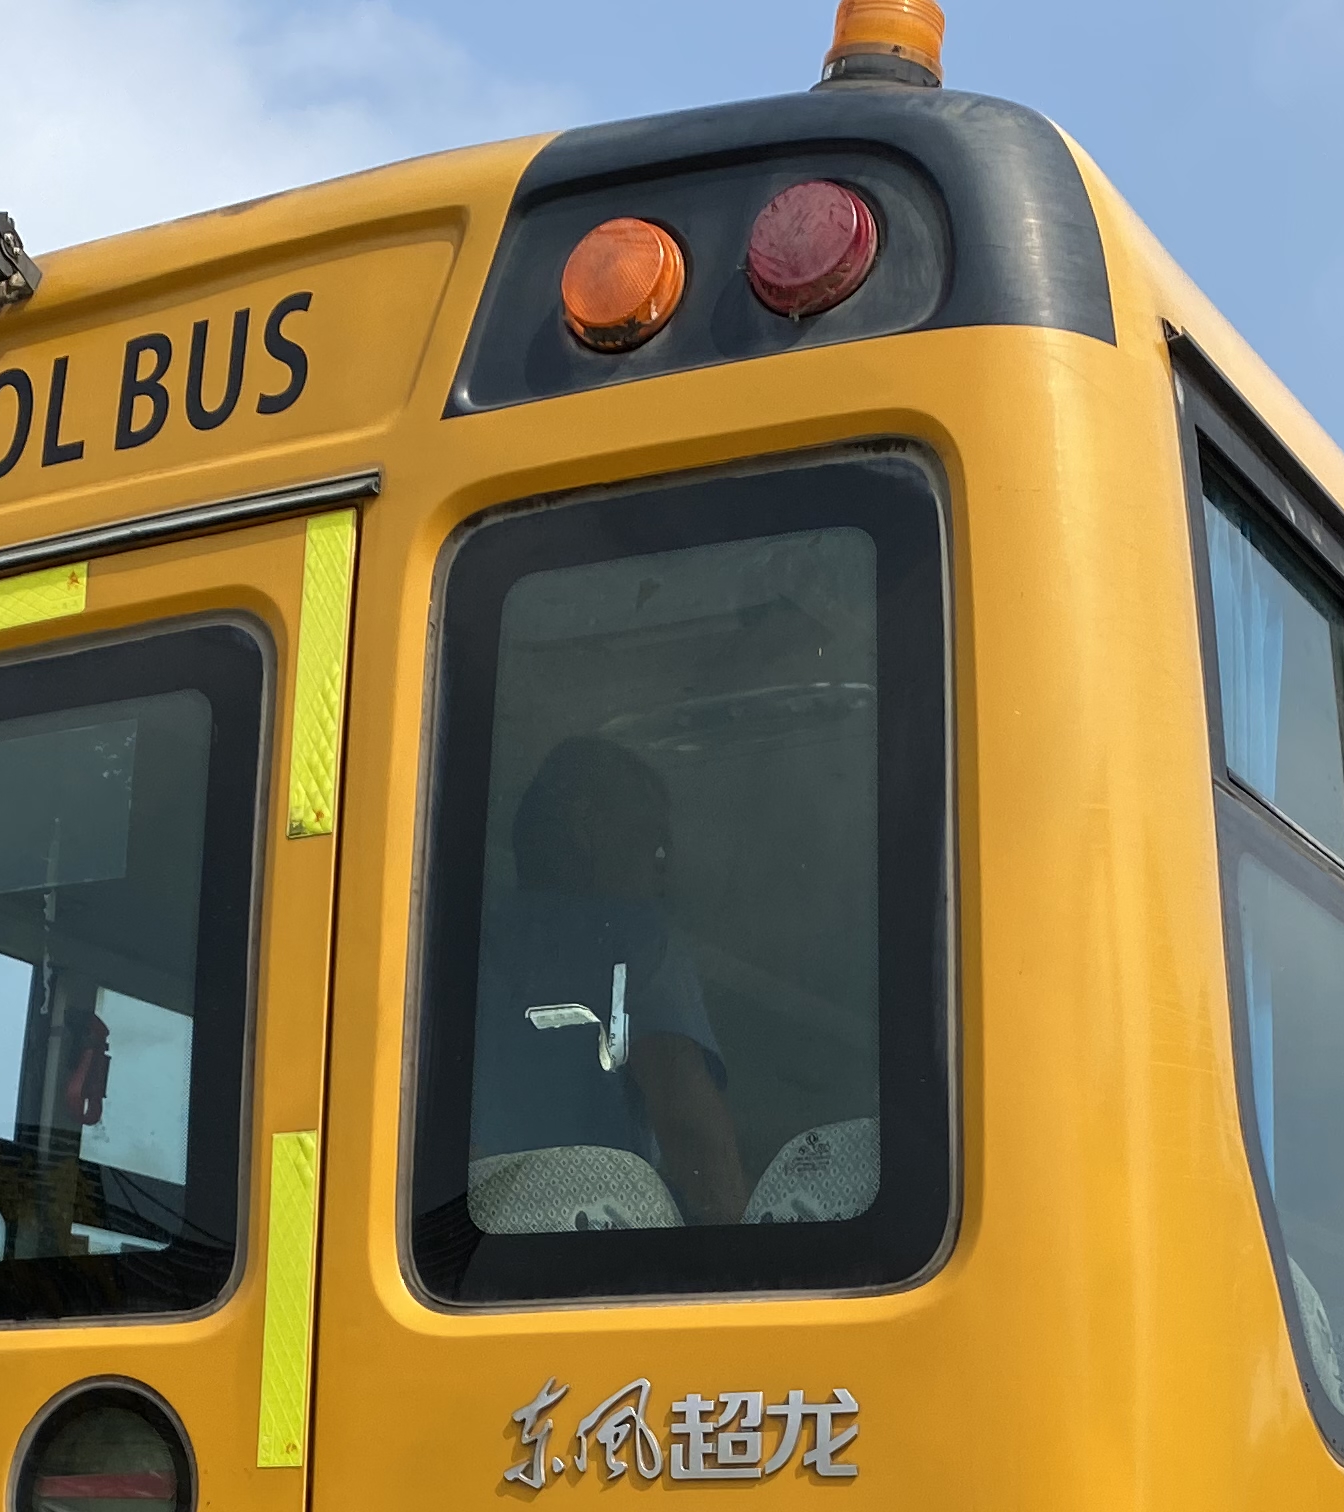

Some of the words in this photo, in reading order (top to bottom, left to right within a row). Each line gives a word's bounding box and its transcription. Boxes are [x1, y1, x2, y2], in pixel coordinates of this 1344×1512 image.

[114, 291, 314, 451] BUS
[503, 1376, 860, 1490] 东风超龙
